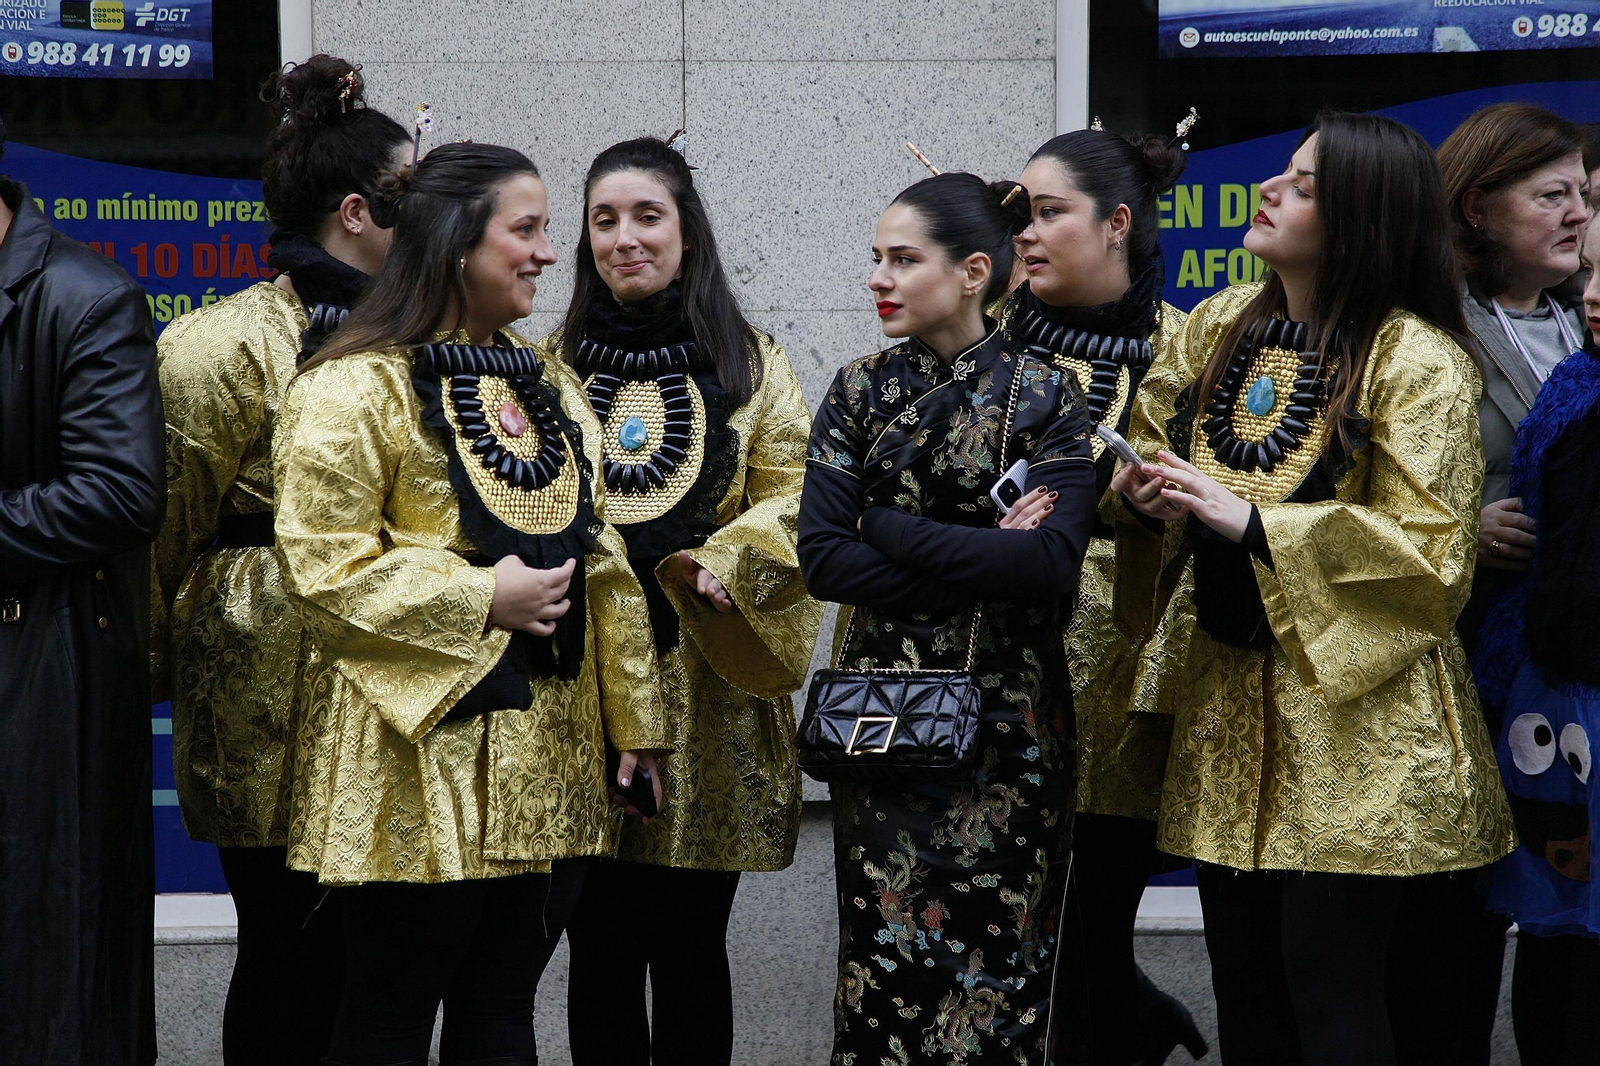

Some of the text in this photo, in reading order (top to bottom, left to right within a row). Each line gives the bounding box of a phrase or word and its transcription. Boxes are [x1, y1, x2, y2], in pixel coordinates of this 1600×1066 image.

[0, 0, 47, 8] RIZADO
[39, 9, 46, 19] E
[156, 8, 191, 22] DGT
[6, 20, 34, 31] VIAL
[1537, 13, 1588, 38] 988
[1203, 26, 1419, 44] autoescuelaponte@yahoo.com.es
[28, 41, 191, 68] 988 41 11 99
[53, 197, 88, 220] ao
[96, 192, 199, 222] mínimo
[207, 200, 270, 228] prez
[130, 242, 179, 278] 10
